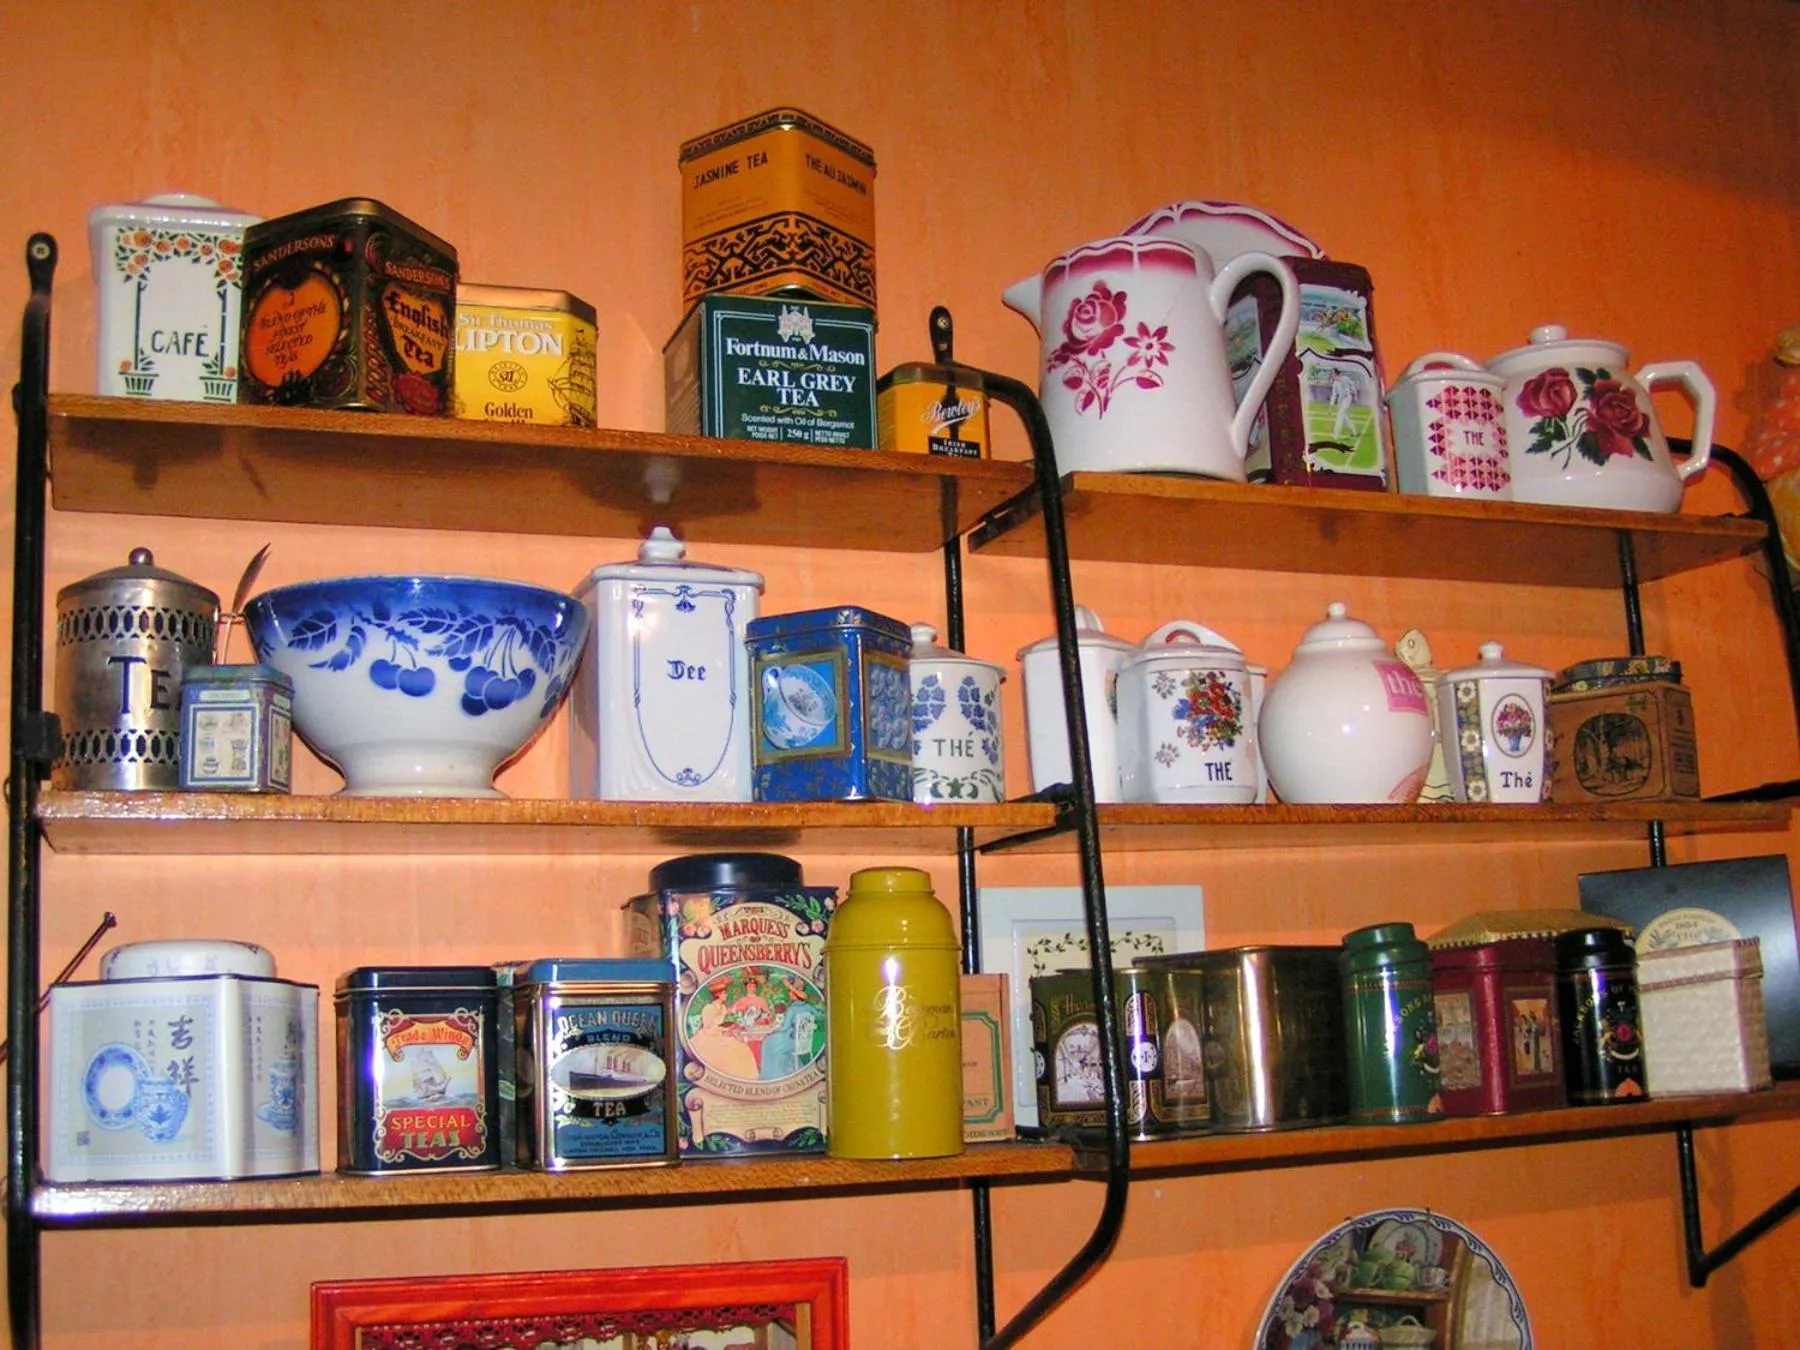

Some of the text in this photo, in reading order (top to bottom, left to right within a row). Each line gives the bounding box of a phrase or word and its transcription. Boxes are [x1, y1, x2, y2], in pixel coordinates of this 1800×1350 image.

[693, 152, 769, 189] JASMINE TEA
[253, 234, 336, 272] SANDERSONS
[384, 261, 450, 292] SANDERSONS
[385, 290, 450, 339] English
[402, 335, 434, 369] Tea
[455, 327, 564, 357] LIPTON
[737, 367, 857, 393] EARL GREY
[484, 401, 534, 418] Golden
[776, 388, 820, 407] TEA
[741, 412, 775, 424] Scented
[777, 417, 793, 425] with
[787, 428, 802, 439] 250
[932, 731, 974, 758] THÉ
[1500, 771, 1534, 788] Thé
[719, 917, 790, 940] MARQUESS
[697, 942, 813, 975] QUEENSBERRY'S
[557, 1010, 607, 1036] OCEAN
[586, 1034, 632, 1043] BLEND
[592, 1101, 627, 1118] TEA
[391, 1115, 471, 1130] SPECIAL
[399, 1130, 462, 1149] TEAS
